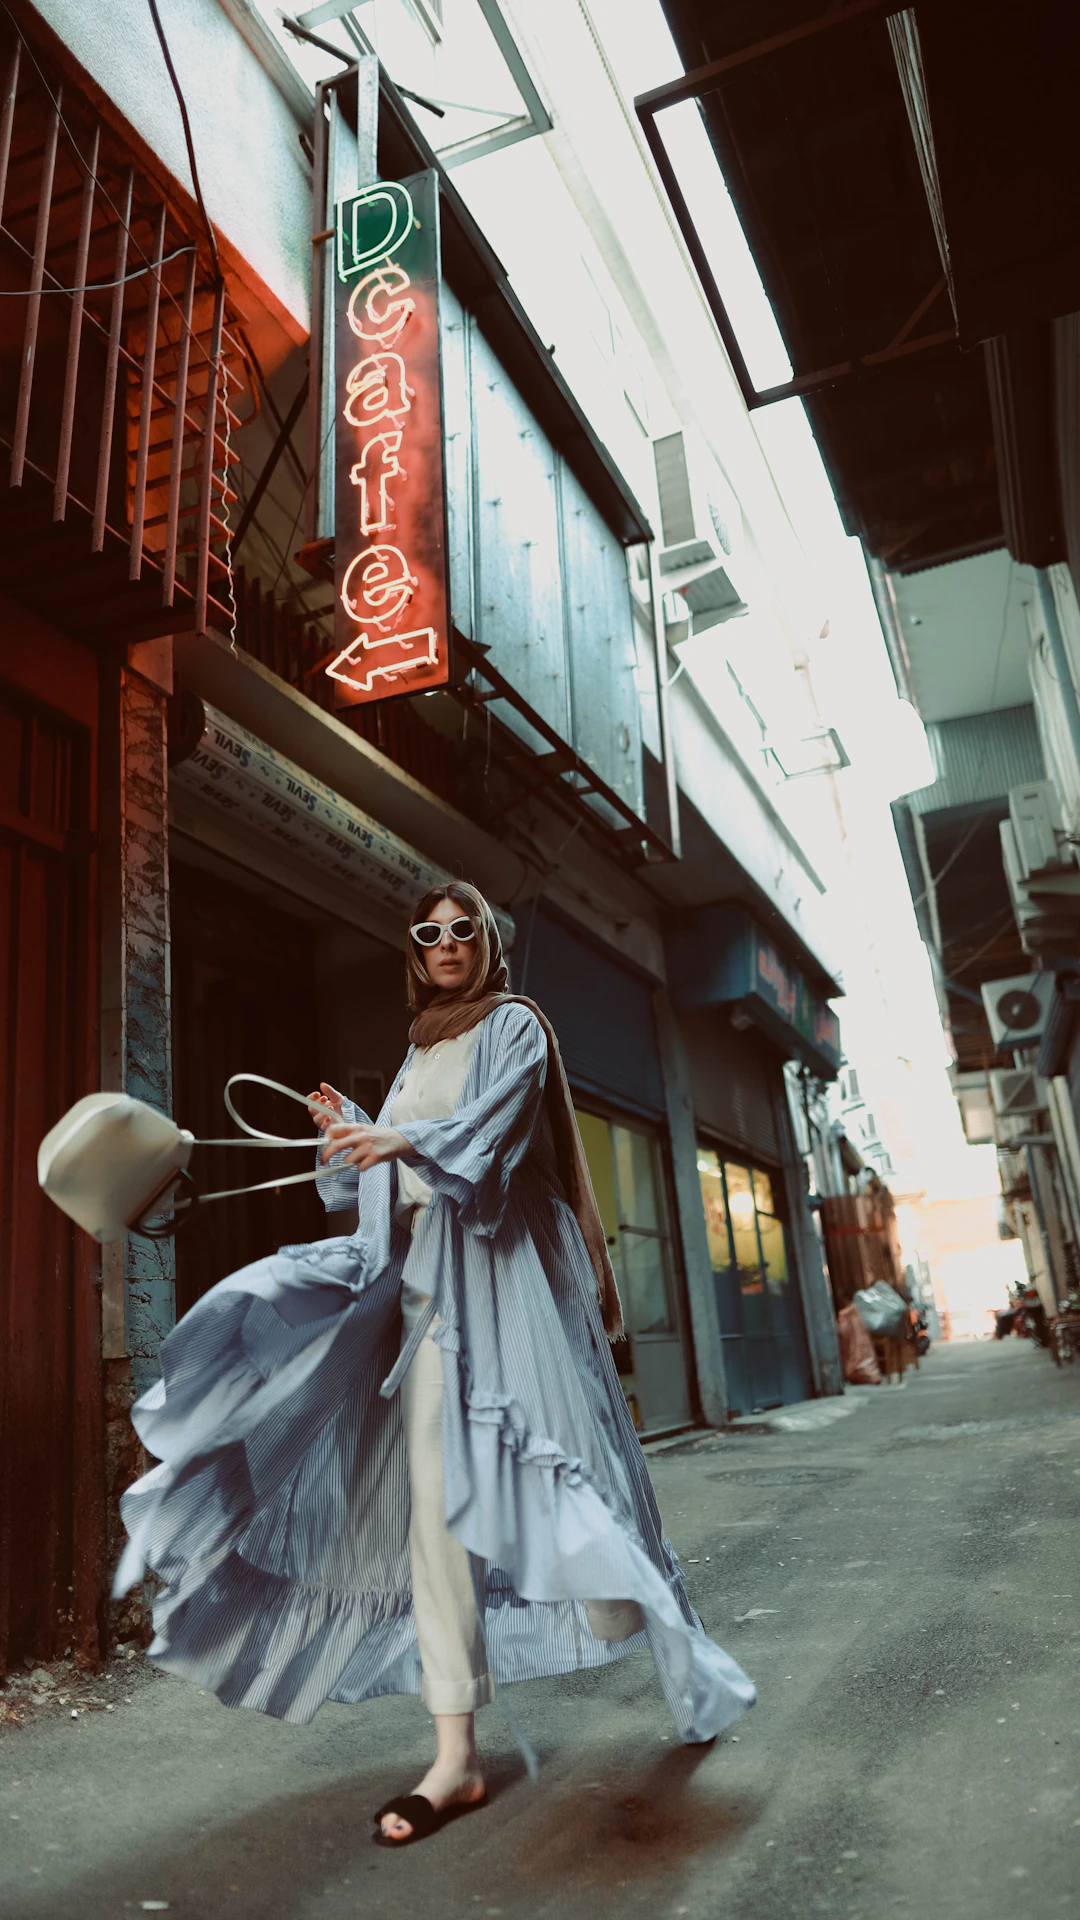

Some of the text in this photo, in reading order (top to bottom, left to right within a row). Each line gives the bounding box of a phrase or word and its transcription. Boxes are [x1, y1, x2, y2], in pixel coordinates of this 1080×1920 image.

[190, 749, 228, 780] SEVI
[214, 729, 251, 768] SEVIL
[286, 777, 317, 812] SEVIL
[347, 818, 374, 849] SEVIL
